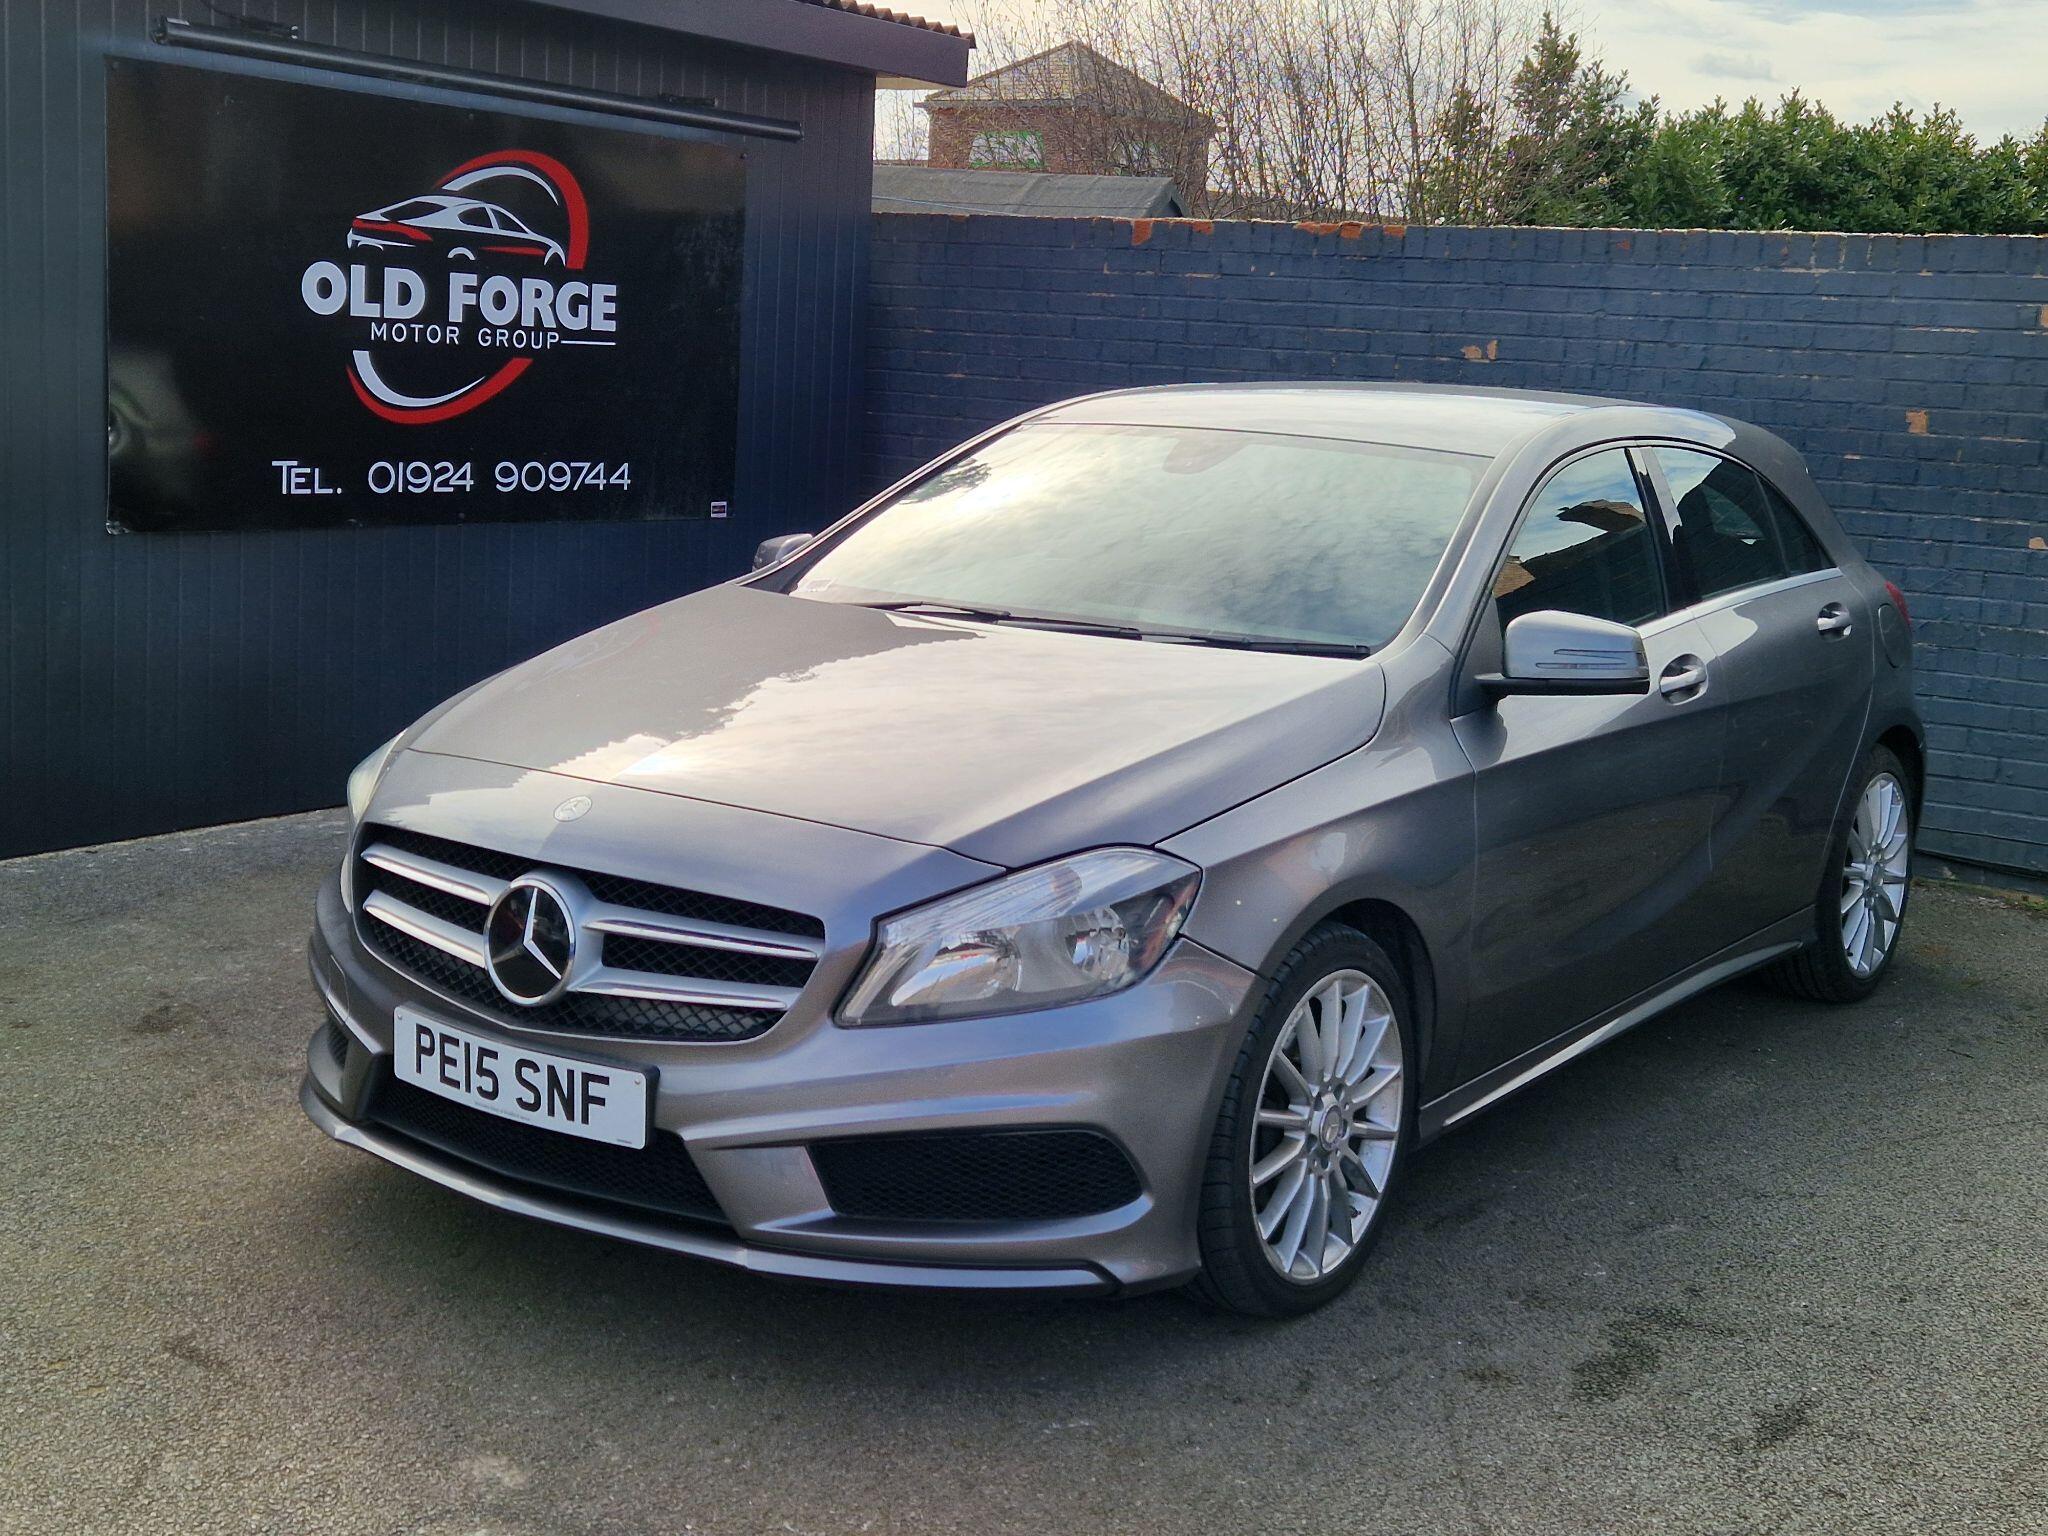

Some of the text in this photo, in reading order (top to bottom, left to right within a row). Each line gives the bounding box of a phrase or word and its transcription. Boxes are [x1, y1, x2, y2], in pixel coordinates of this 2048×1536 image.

[301, 260, 617, 332] OLD FORGE
[371, 322, 560, 349] MOTOR GROUP
[368, 461, 475, 493] 01924
[494, 461, 631, 491] 909744
[415, 1023, 610, 1125] PE15 SNF
